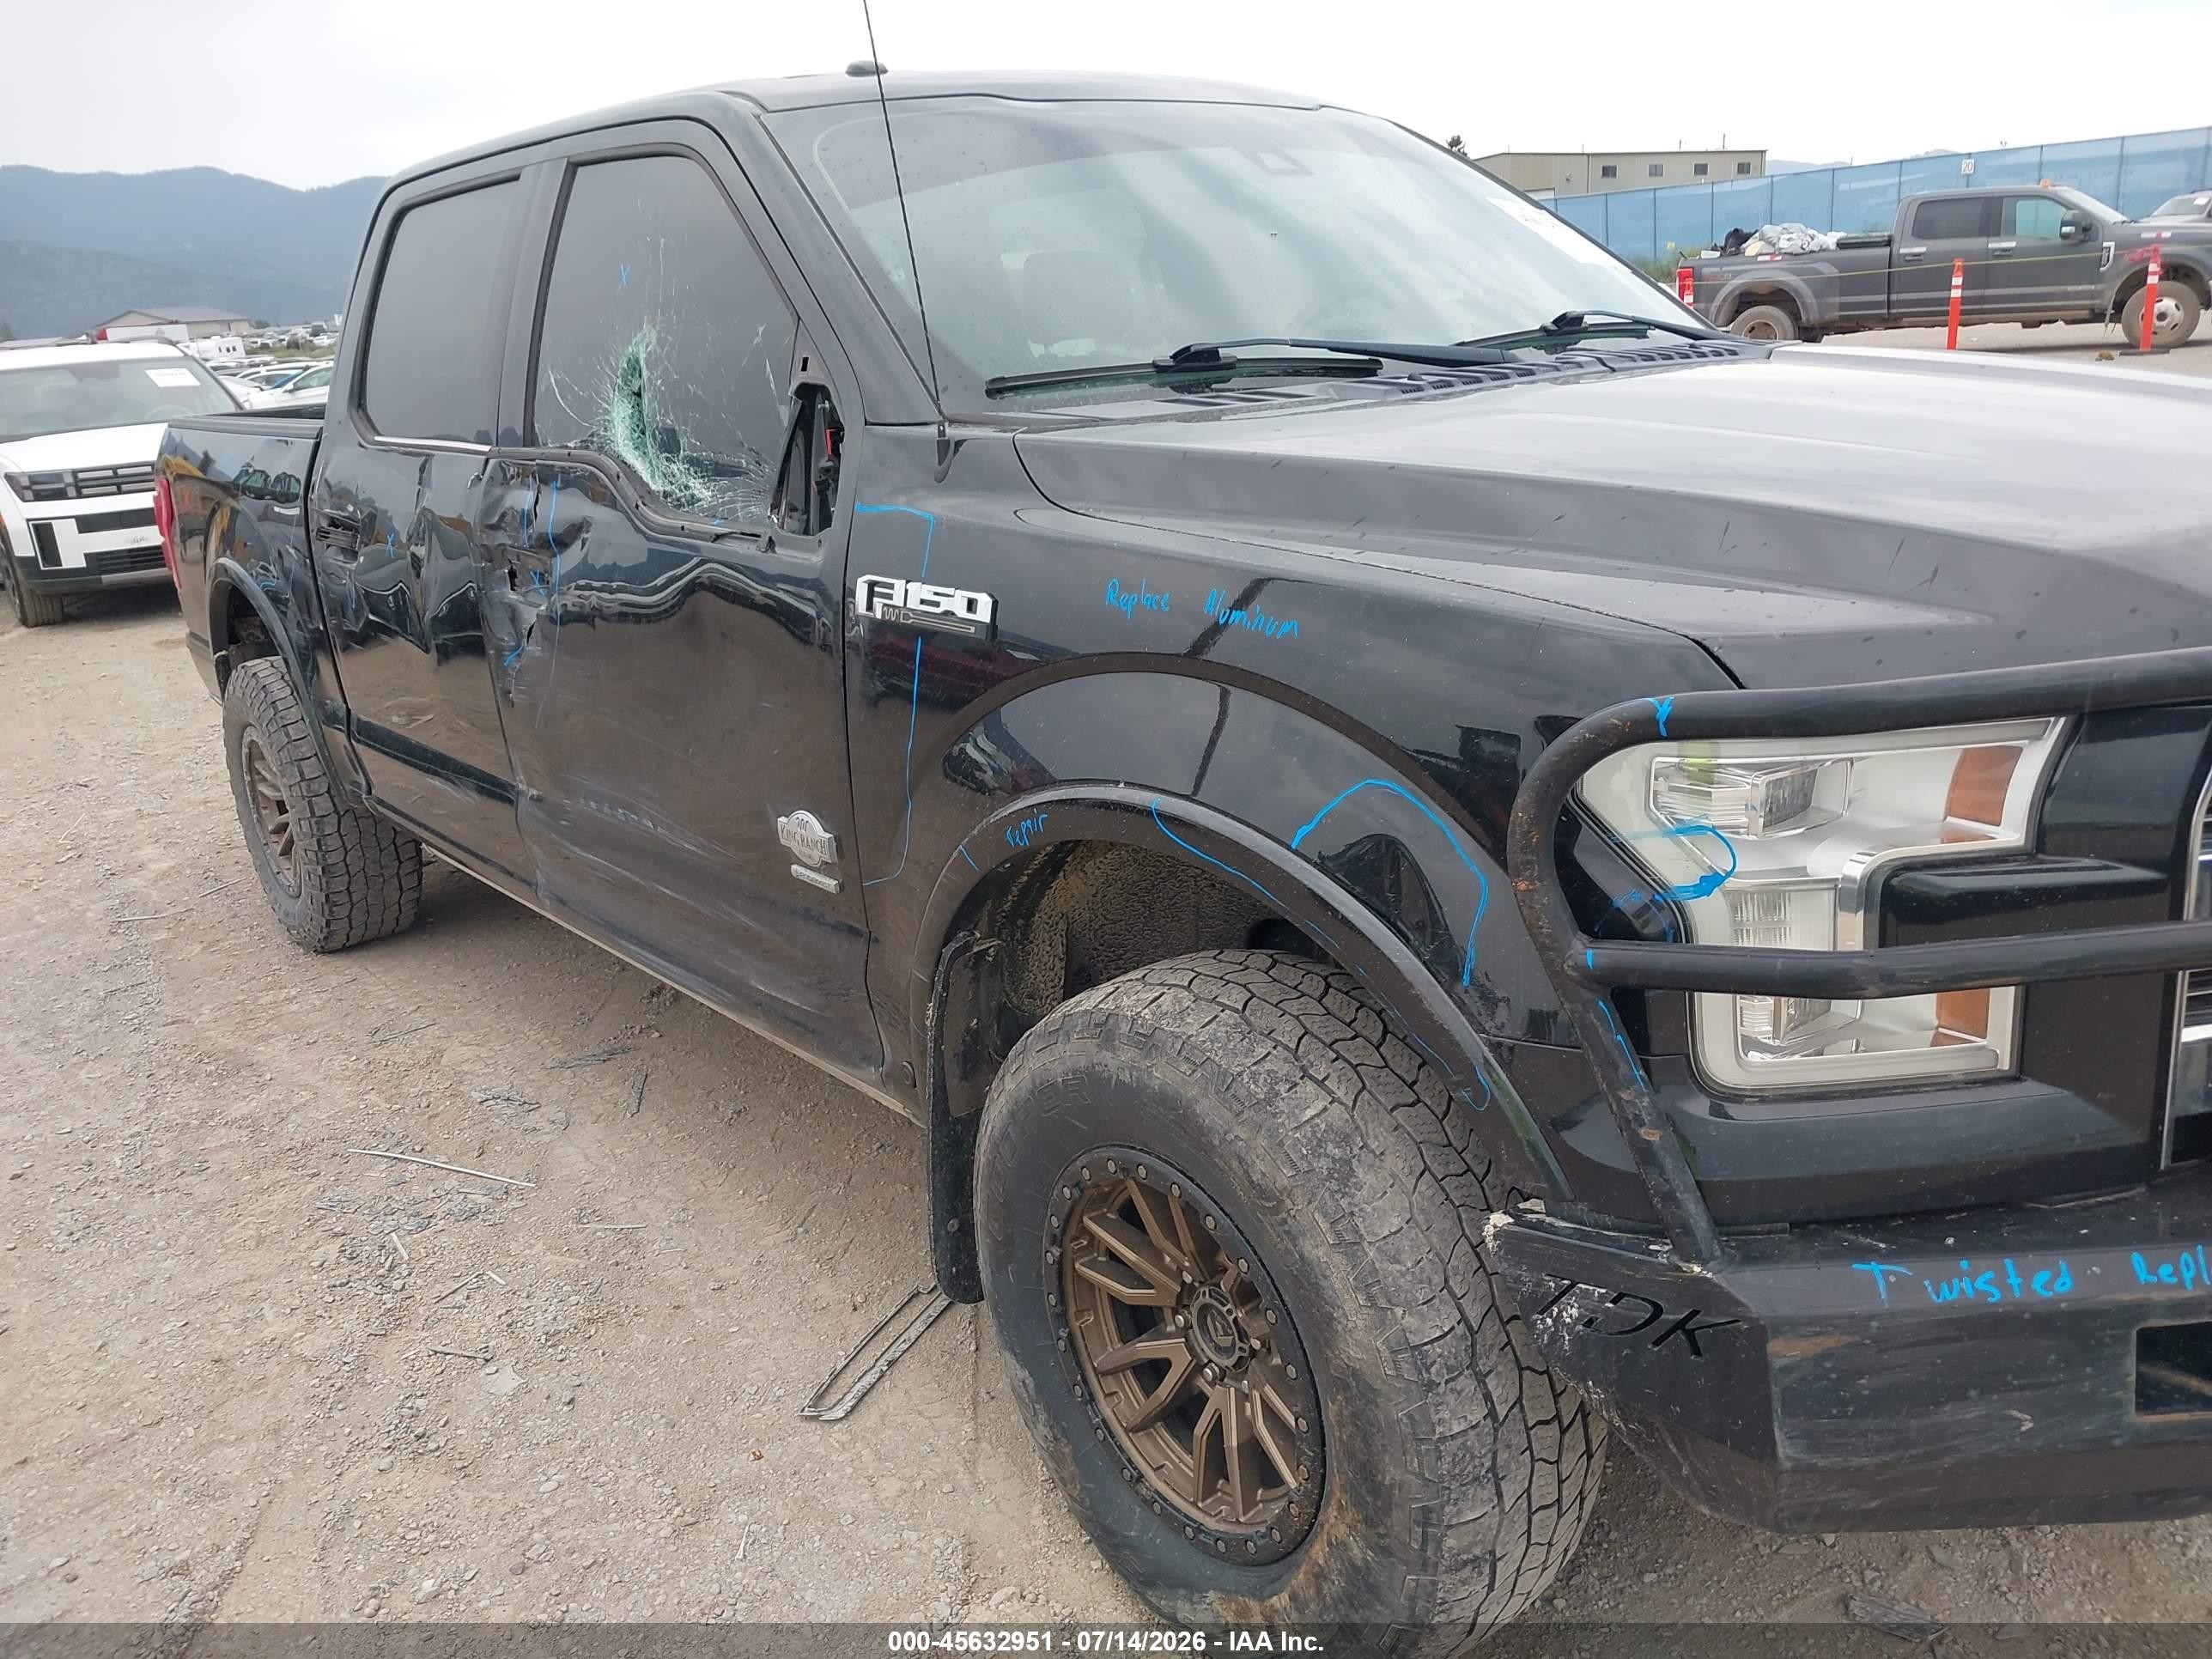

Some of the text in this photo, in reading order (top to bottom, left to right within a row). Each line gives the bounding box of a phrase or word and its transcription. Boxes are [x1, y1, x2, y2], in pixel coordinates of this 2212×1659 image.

[1963, 161, 1973, 173] 20
[1105, 577, 1299, 639] Replace Aluminum
[781, 823, 800, 845] KING
[799, 832, 828, 856] RANCH
[1534, 1273, 1742, 1361] TDK
